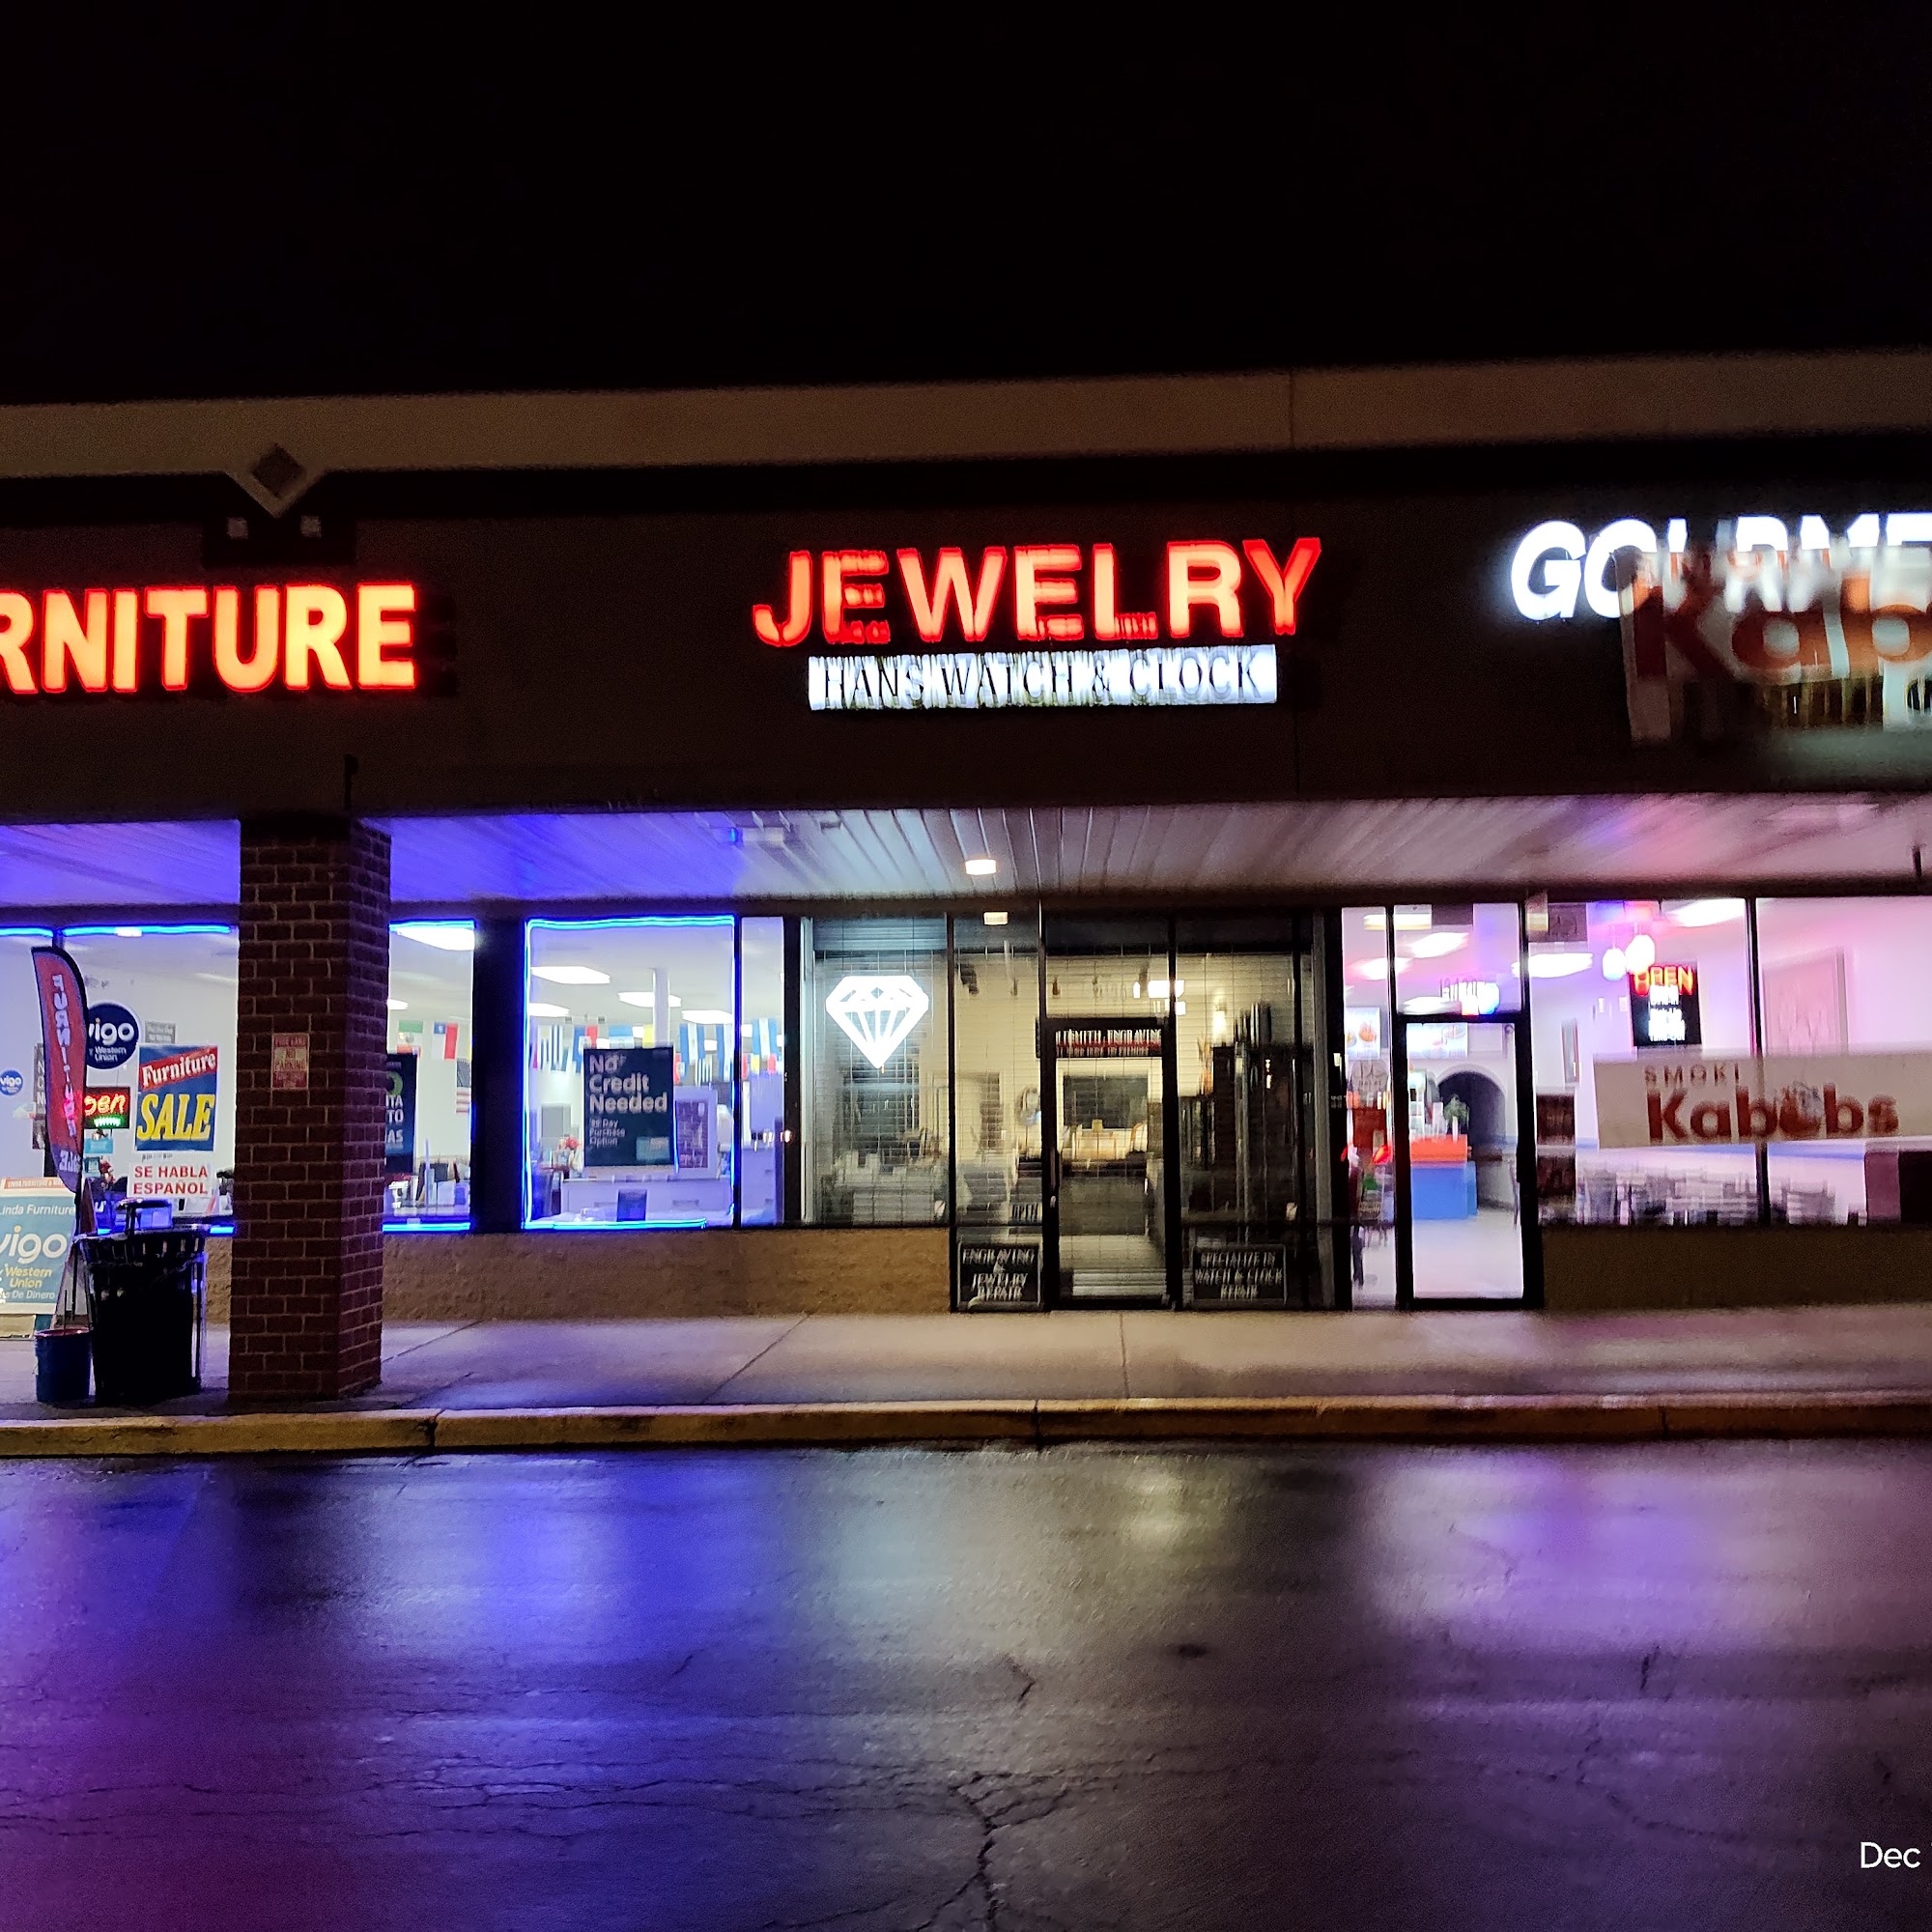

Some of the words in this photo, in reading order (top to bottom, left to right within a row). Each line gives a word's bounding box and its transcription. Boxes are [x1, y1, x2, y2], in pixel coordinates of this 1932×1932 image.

[753, 537, 1321, 647] JEWELRY
[823, 658, 925, 709] HANS
[936, 652, 1074, 709] WATCH
[1128, 646, 1263, 703] CLOCK
[95, 1047, 127, 1056] Western
[141, 1053, 216, 1088] Furniture
[589, 1072, 650, 1094] Credit
[589, 1092, 668, 1114] Needed
[136, 1094, 215, 1142] SALE
[134, 1165, 153, 1179] SE
[157, 1165, 208, 1179] HABLA
[133, 1179, 209, 1195] ESPAÑOL
[26, 1204, 74, 1216] Furniture
[5, 1264, 53, 1277] Western
[10, 1277, 43, 1289] Union
[12, 1290, 24, 1299] De
[26, 1290, 56, 1300] Dinero
